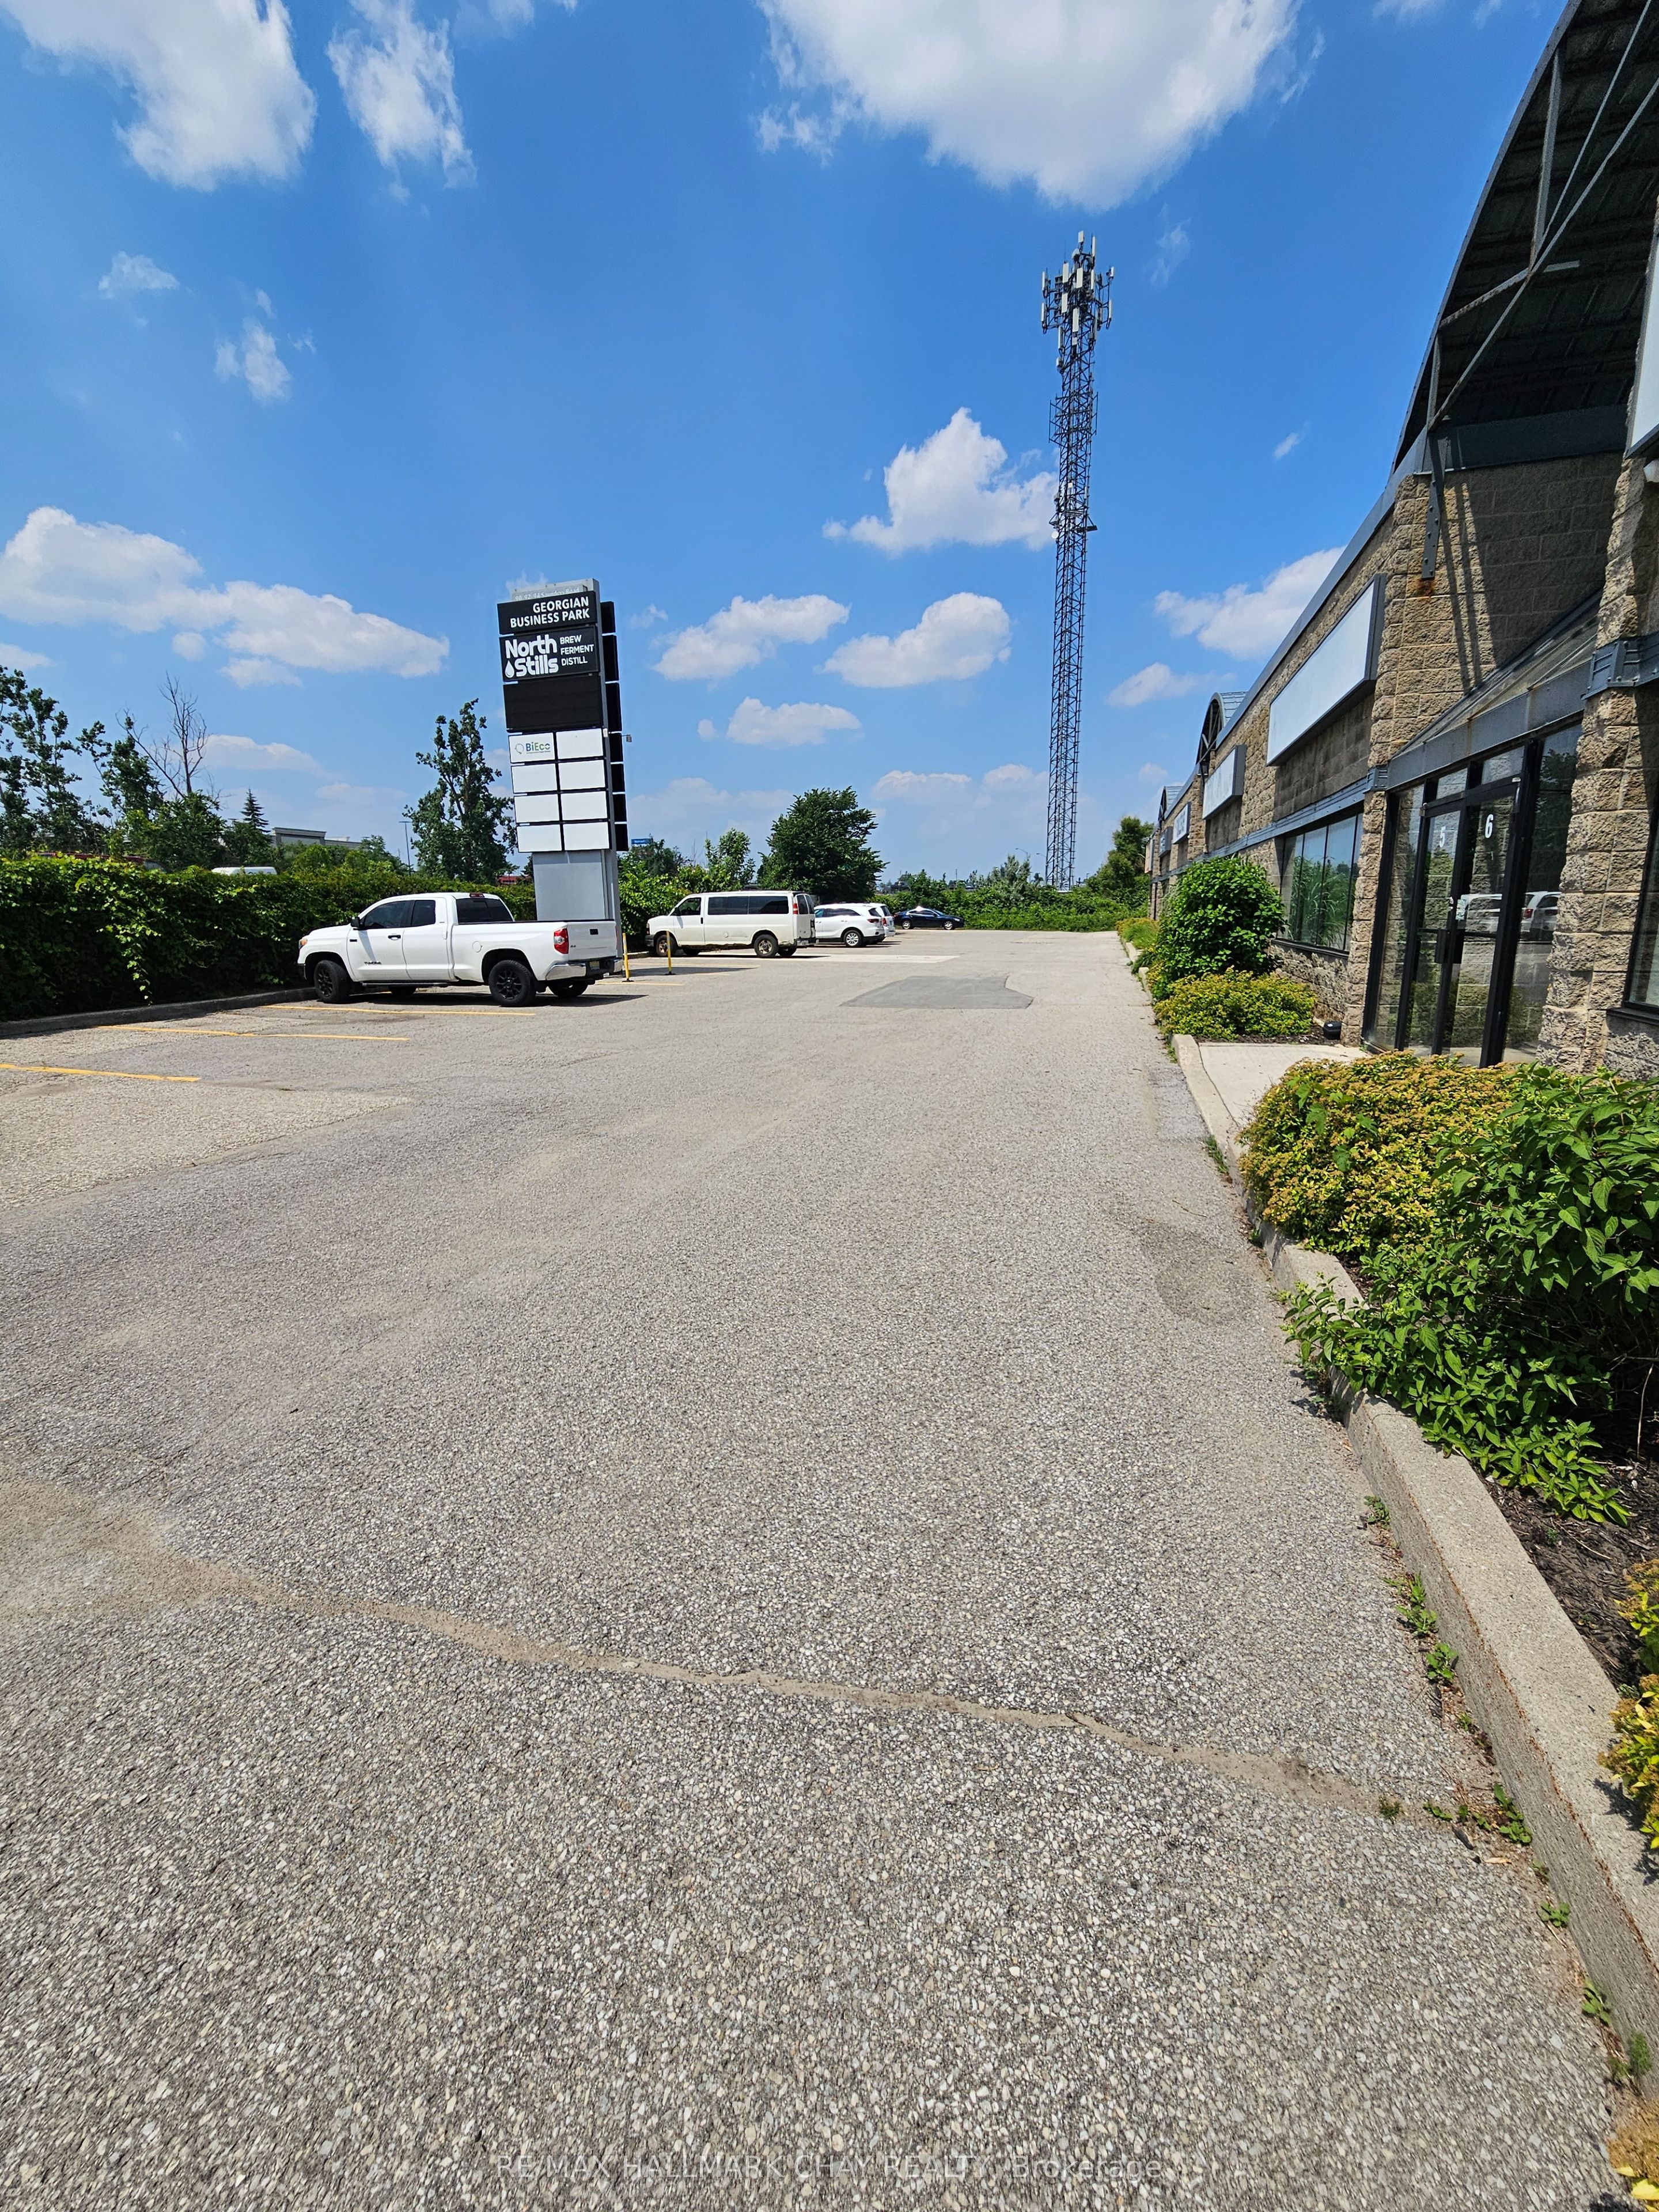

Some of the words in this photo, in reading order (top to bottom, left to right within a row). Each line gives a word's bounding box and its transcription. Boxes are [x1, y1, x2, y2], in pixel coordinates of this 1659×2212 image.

[533, 596, 589, 613] GEORGIAN
[510, 612, 559, 628] BUSINESS
[562, 608, 590, 622] PARK
[505, 634, 558, 658] North
[560, 635, 582, 645] BREW
[560, 644, 594, 656] FERMENT
[514, 654, 559, 677] Stills
[561, 656, 588, 666] DISTILL
[526, 741, 551, 751] BiEco
[1484, 814, 1494, 838] 6
[1439, 825, 1446, 848] 5
